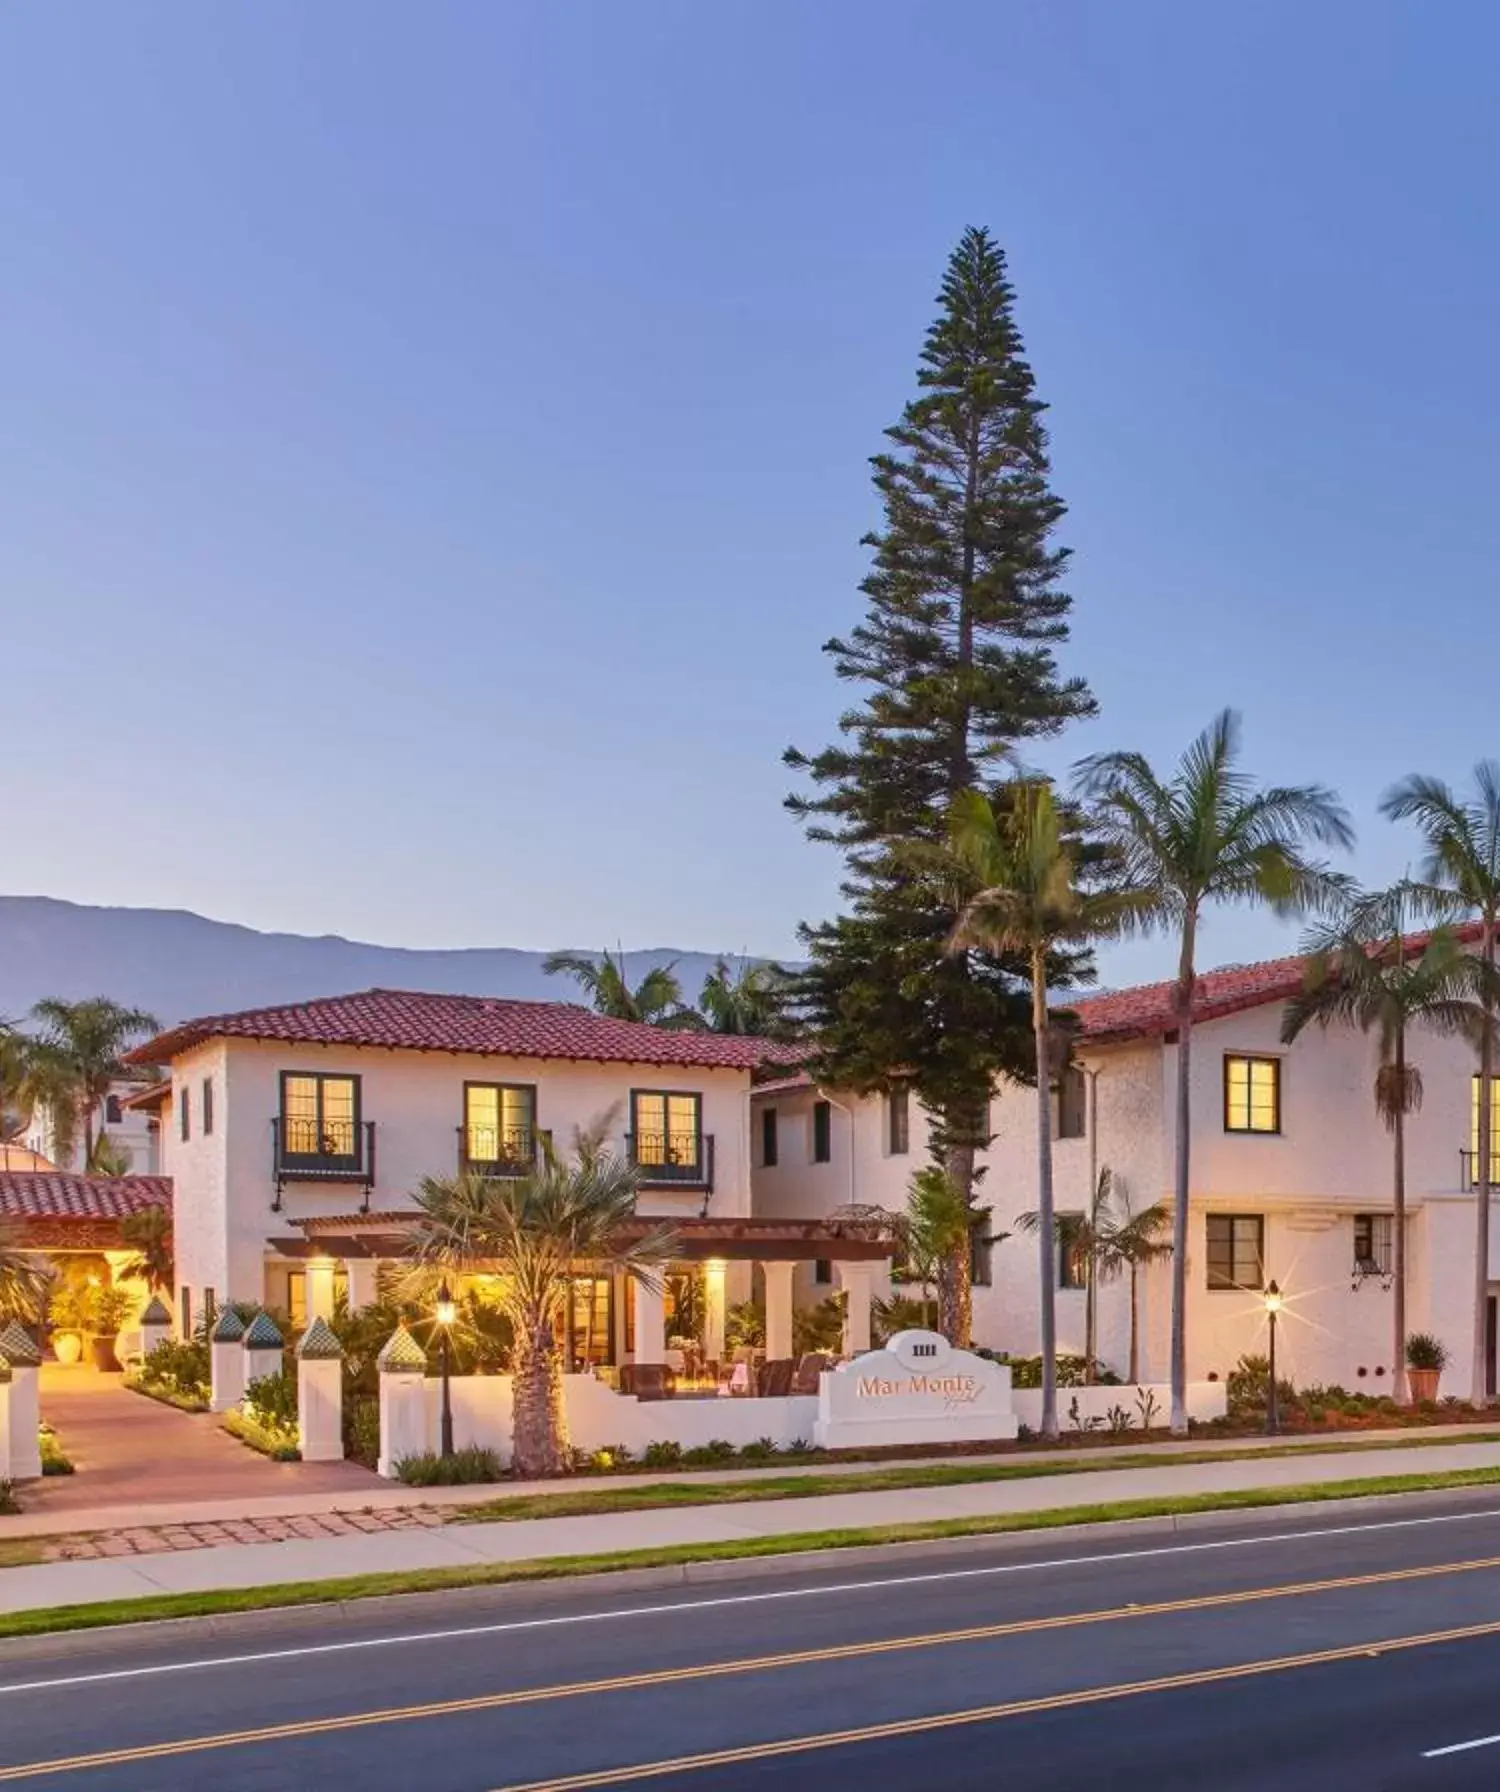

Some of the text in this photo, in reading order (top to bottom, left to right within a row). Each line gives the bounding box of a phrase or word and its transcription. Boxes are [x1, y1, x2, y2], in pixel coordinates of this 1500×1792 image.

[912, 1344, 937, 1357] 1111
[857, 1374, 976, 1397] Mar Monte
